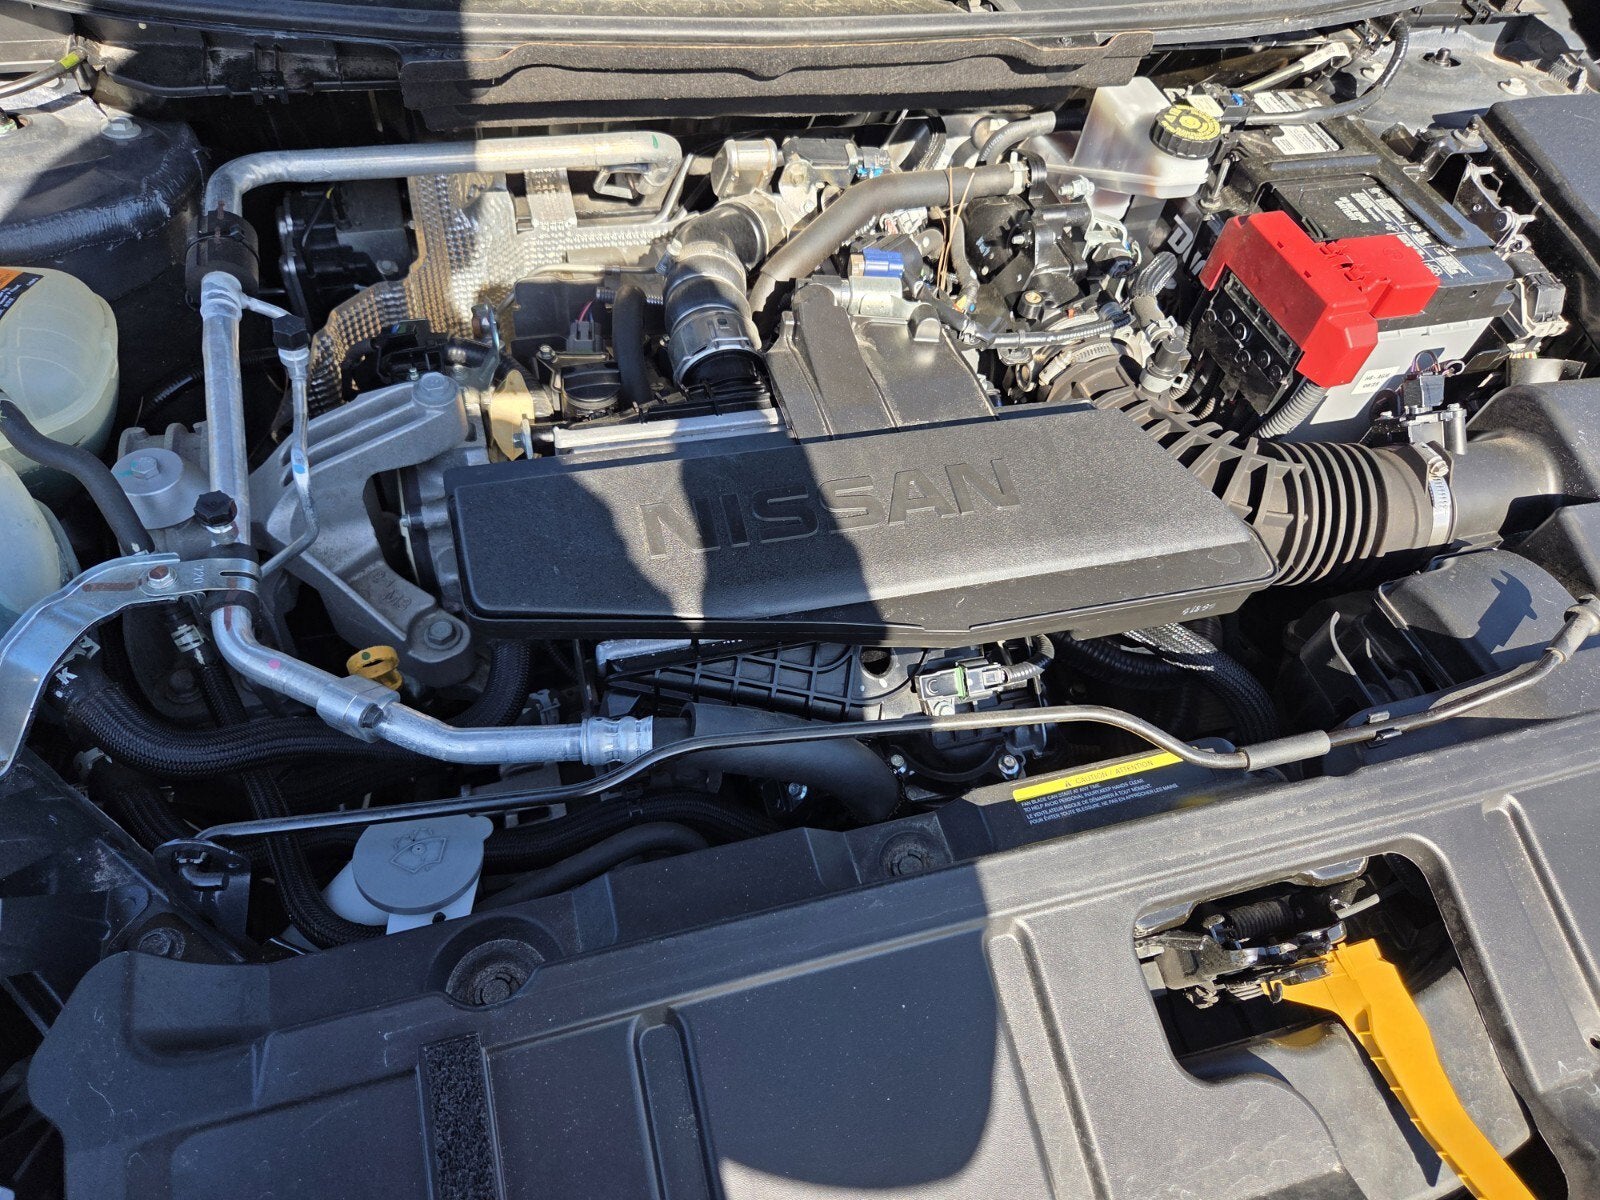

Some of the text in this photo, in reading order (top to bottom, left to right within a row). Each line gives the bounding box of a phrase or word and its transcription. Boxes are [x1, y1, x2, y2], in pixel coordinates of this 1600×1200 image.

[640, 458, 1021, 560] NISSAN
[1076, 772, 1108, 784] CAUTION
[1116, 760, 1154, 774] ATTENTION
